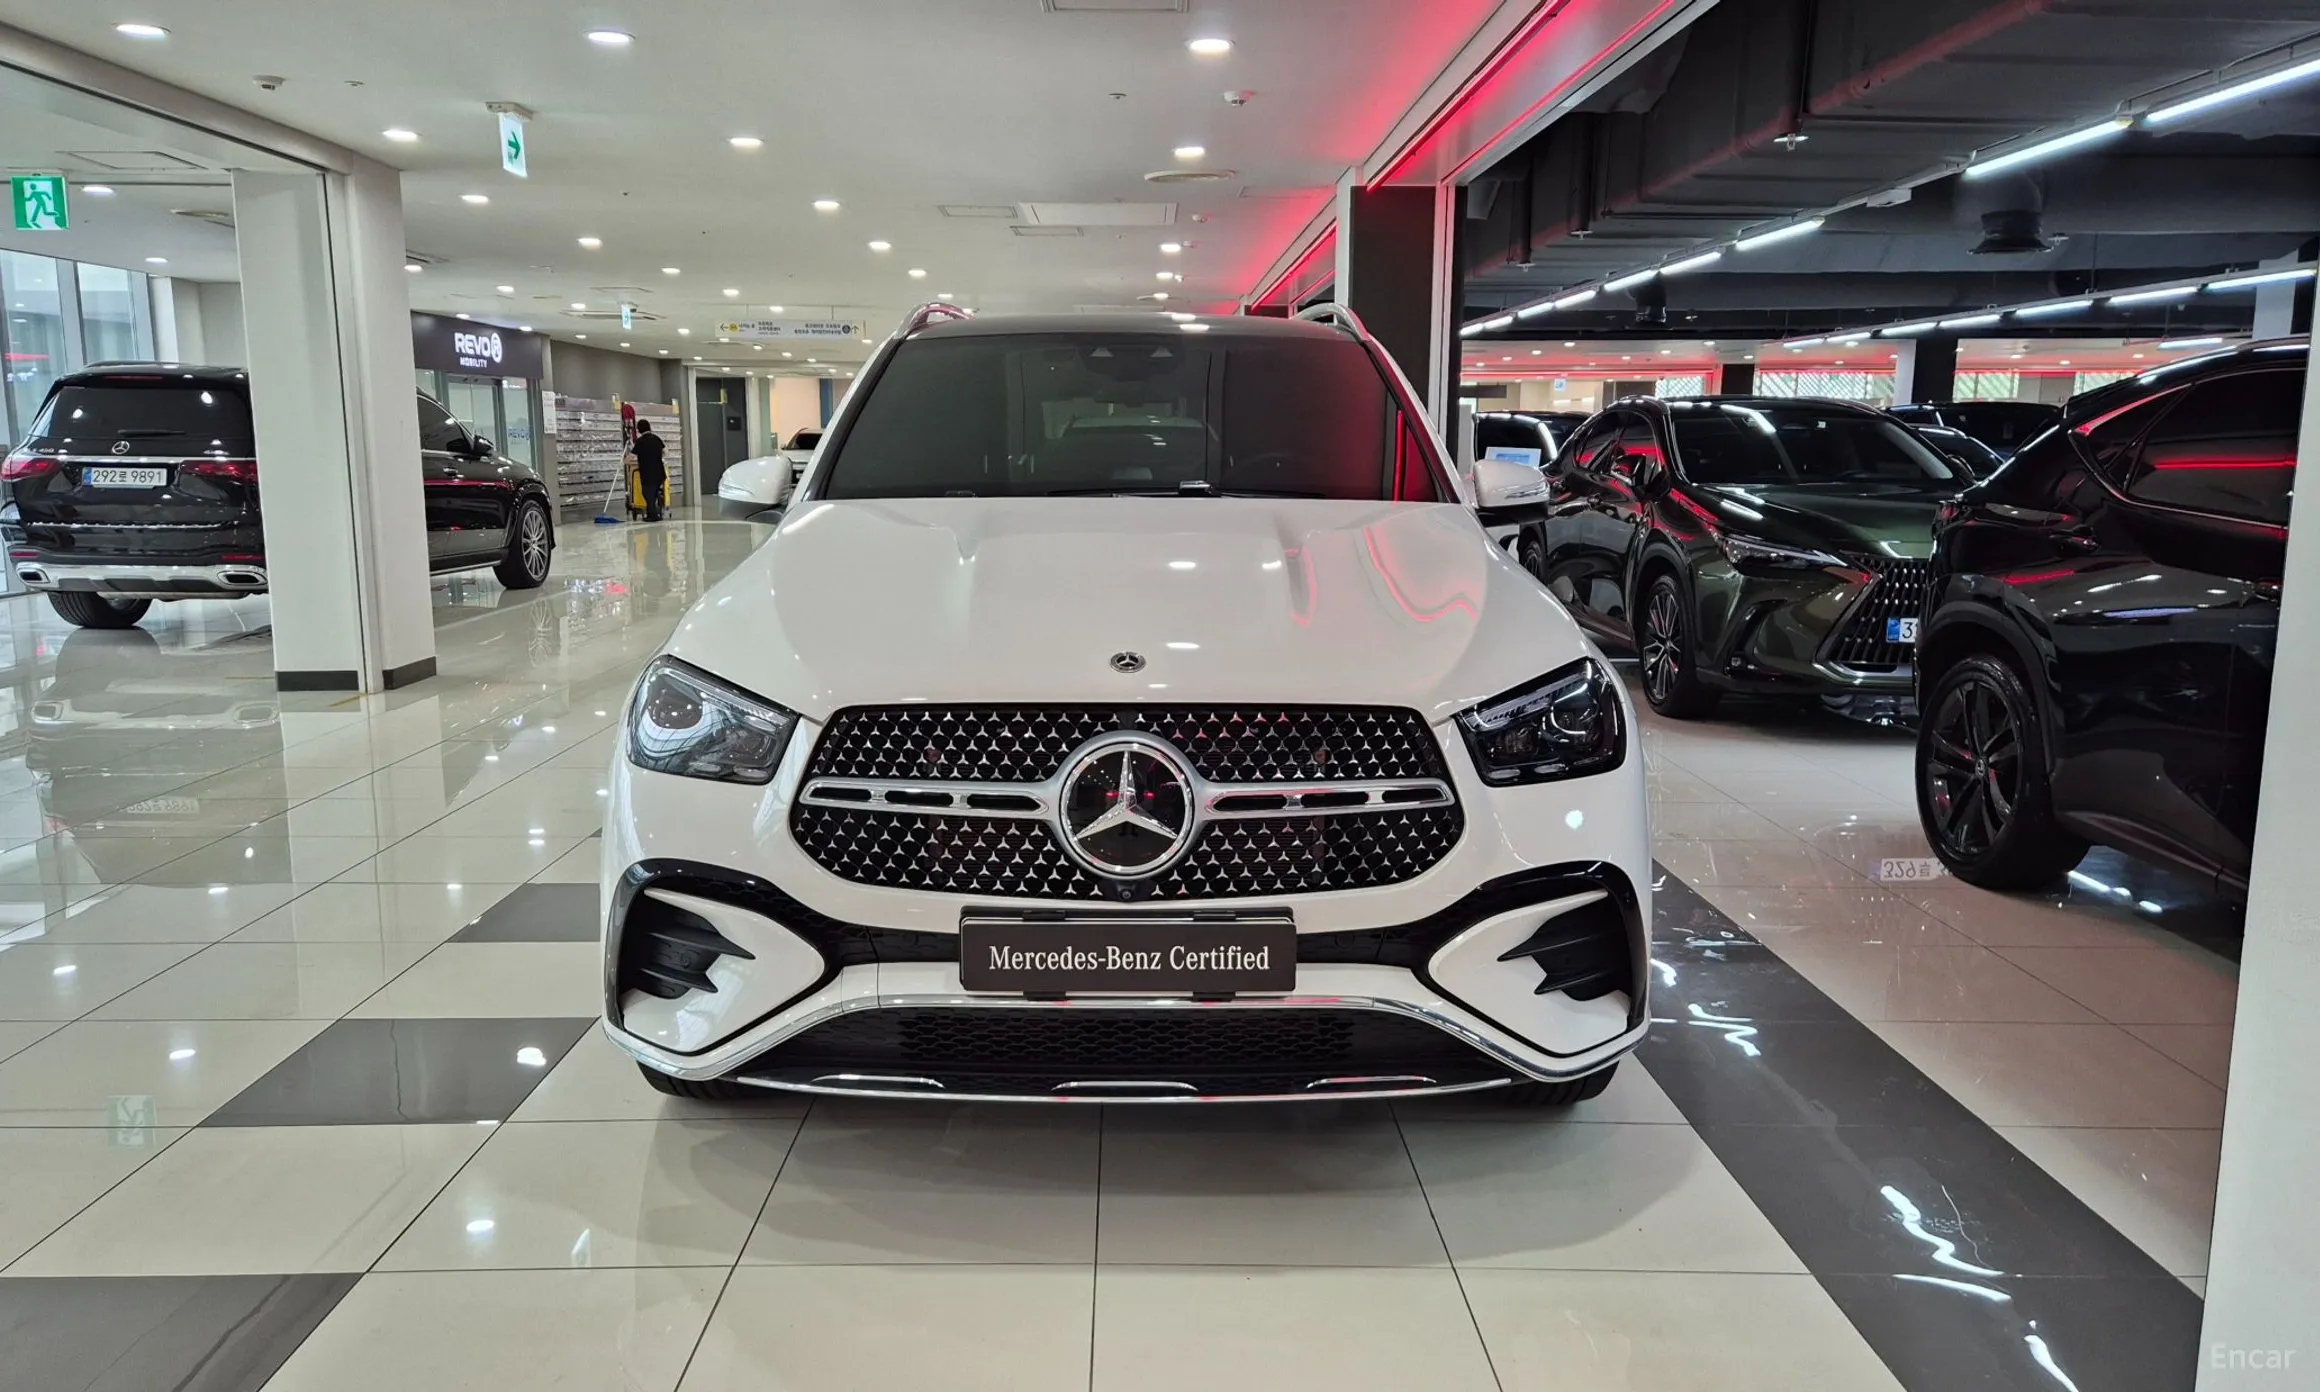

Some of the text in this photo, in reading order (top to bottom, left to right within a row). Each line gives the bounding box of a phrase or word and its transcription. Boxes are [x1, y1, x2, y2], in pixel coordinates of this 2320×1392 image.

[454, 332, 491, 357] REVO
[460, 356, 488, 368] MOBILITY
[93, 469, 162, 483] 292로 9891
[988, 945, 1270, 970] Mercedes-Benz Certified
